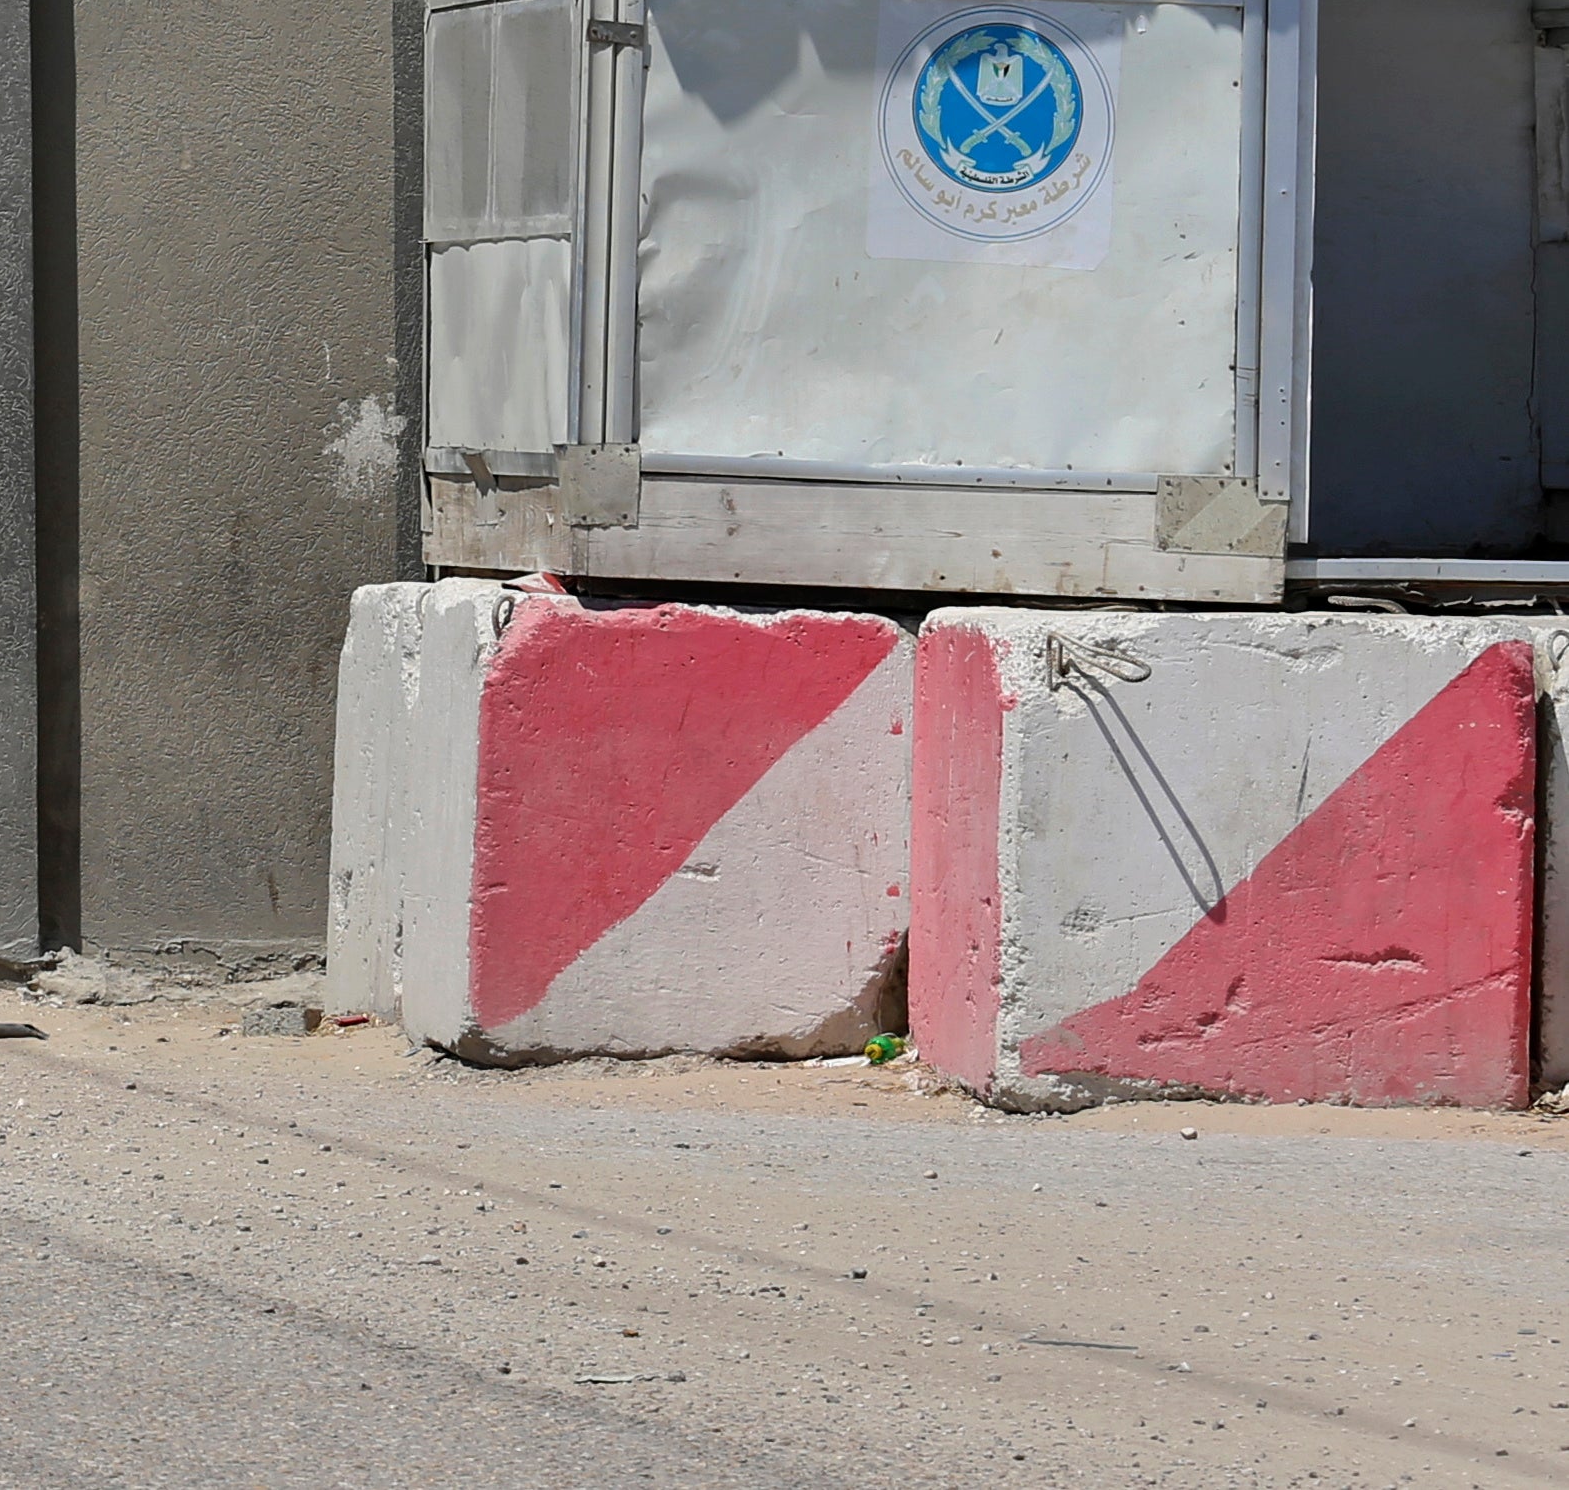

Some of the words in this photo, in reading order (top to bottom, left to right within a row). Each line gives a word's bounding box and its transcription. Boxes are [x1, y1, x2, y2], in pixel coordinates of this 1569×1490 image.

[896, 148, 935, 192] سالم
[960, 166, 998, 185] الفلسطينية
[1000, 171, 1030, 185] الشرطة
[1038, 153, 1092, 205] شرطة
[963, 200, 998, 224] كرم
[1001, 200, 1038, 226] معبر
